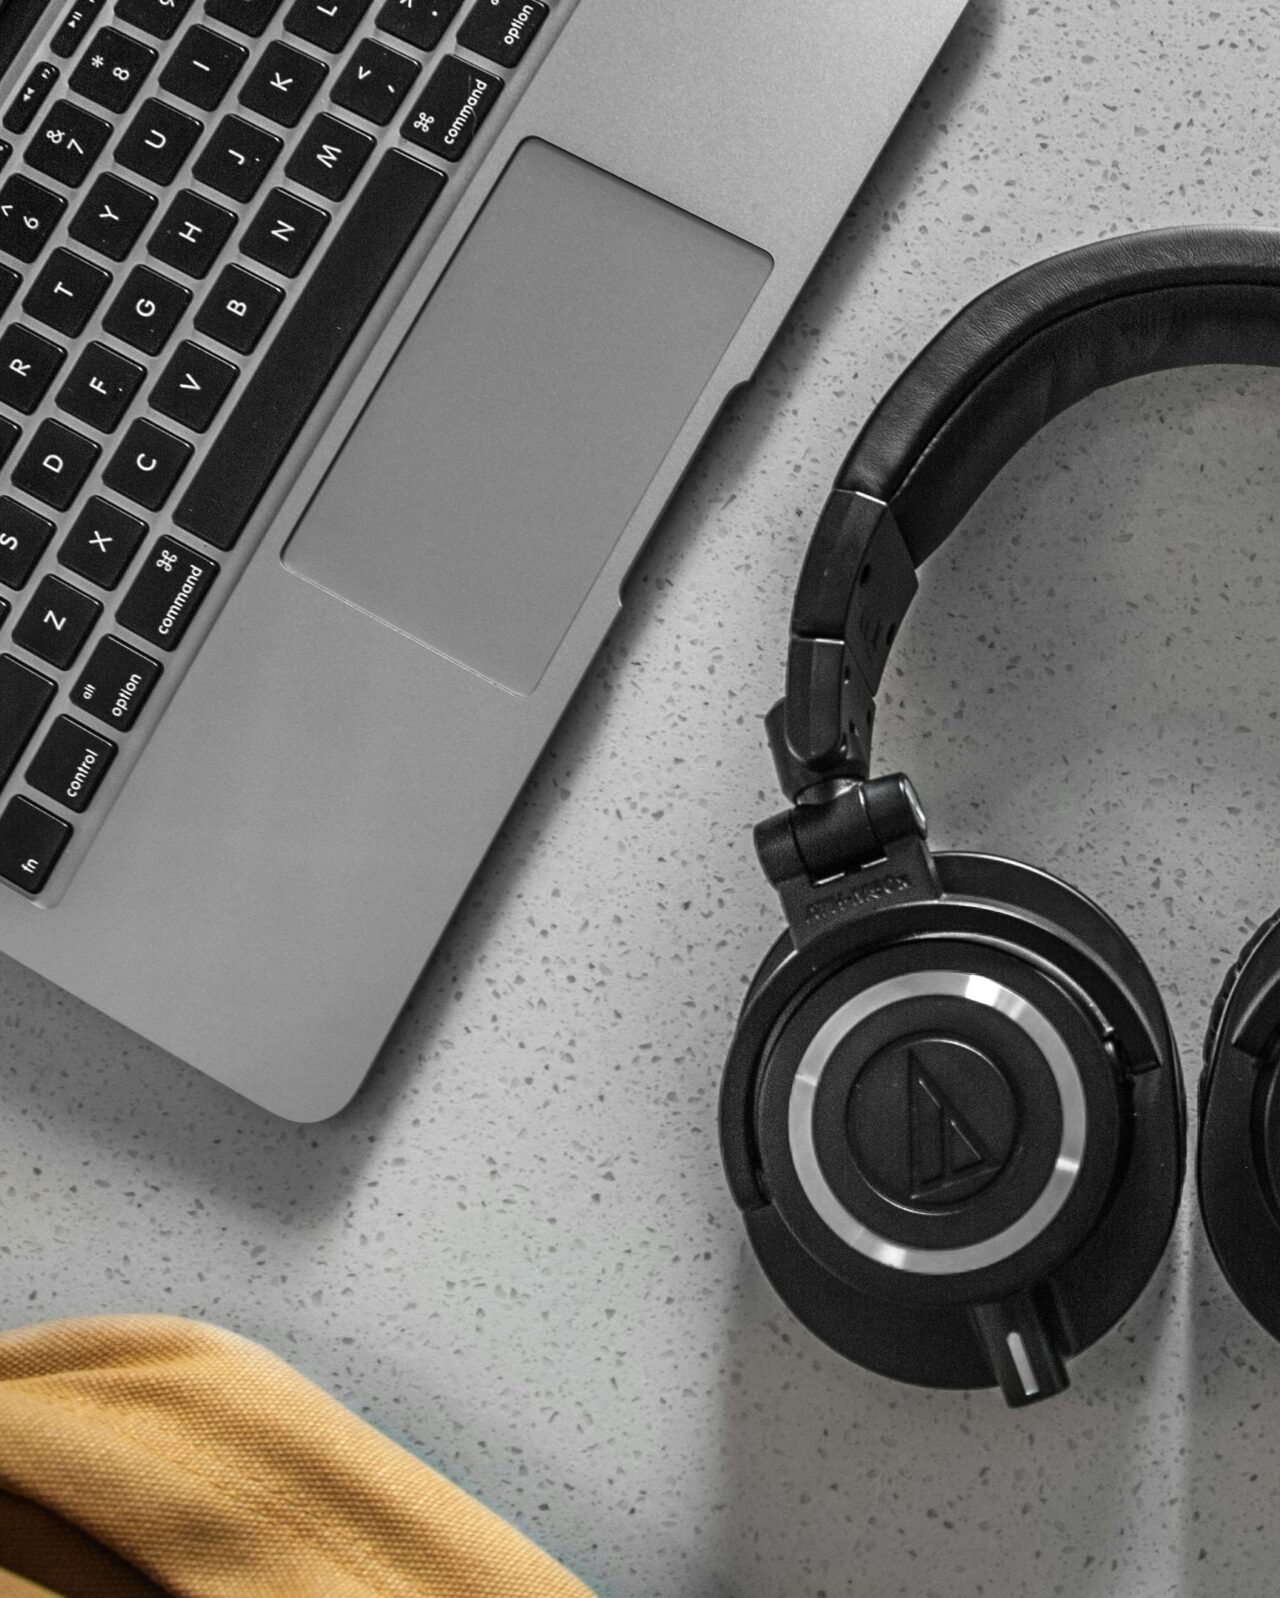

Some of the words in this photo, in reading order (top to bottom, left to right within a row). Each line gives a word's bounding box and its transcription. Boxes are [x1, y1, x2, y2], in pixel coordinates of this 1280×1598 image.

[317, 6, 338, 17] L
[504, 4, 534, 45] option
[113, 67, 130, 81] 8
[270, 72, 294, 92] K
[444, 78, 488, 145] command
[46, 129, 66, 144] &
[145, 129, 167, 149] U
[67, 138, 84, 155] 7
[228, 149, 246, 165] J
[316, 144, 342, 169] M
[98, 204, 120, 221] Y
[23, 215, 39, 230] 6
[179, 221, 203, 243] H
[271, 219, 295, 242] N
[53, 281, 74, 297] T
[136, 298, 156, 318] G
[227, 299, 247, 317] B
[8, 358, 31, 377] R
[88, 376, 107, 395] F
[180, 373, 202, 391] V
[42, 454, 64, 474] D
[137, 453, 157, 472] C
[0, 532, 18, 551] S
[88, 531, 113, 553] X
[158, 564, 203, 635] command
[43, 609, 67, 631] Z
[82, 683, 97, 701] alt
[111, 673, 142, 717] option
[66, 748, 98, 798] control
[21, 858, 39, 874] fn
